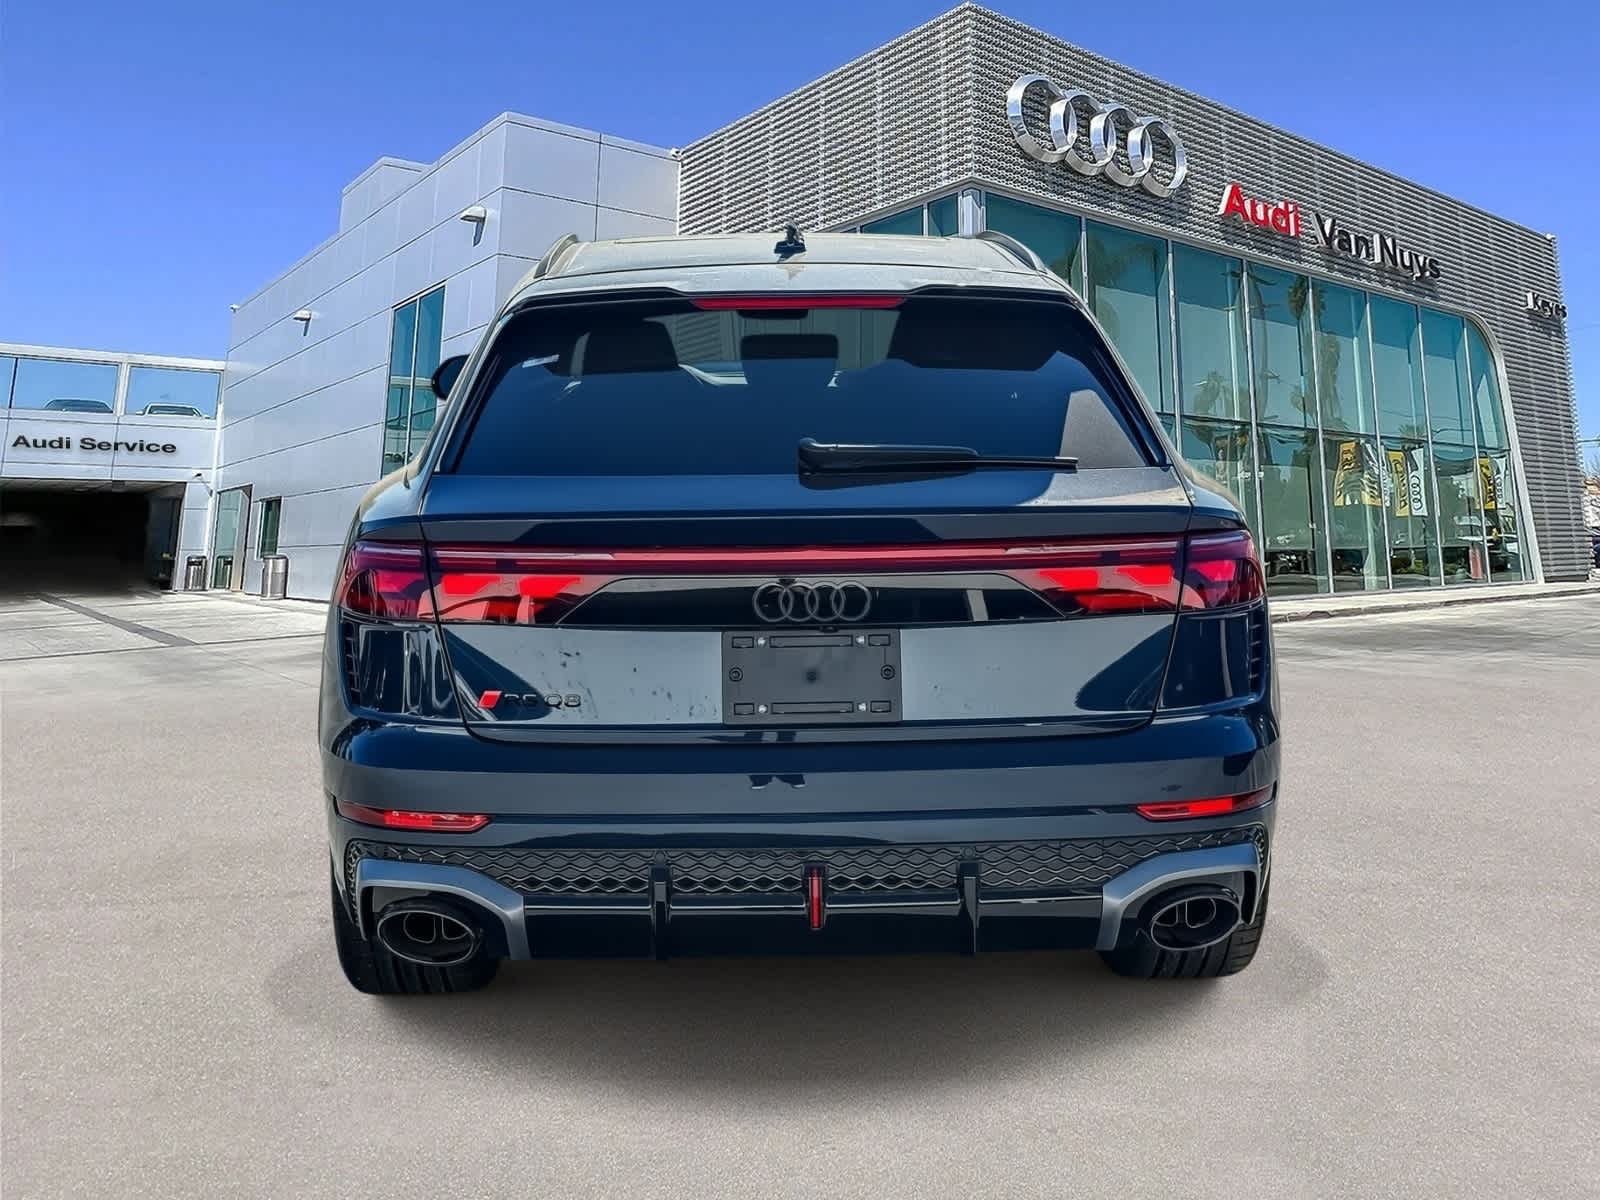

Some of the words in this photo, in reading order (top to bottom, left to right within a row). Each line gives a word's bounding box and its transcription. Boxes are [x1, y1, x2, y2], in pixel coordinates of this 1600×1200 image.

[1219, 182, 1302, 237] Audi
[1312, 212, 1370, 259] Van
[1374, 233, 1441, 280] Nuys
[1527, 291, 1568, 319] Keyes
[12, 434, 71, 449] Audi
[80, 437, 177, 453] Service
[544, 693, 582, 709] Q8
